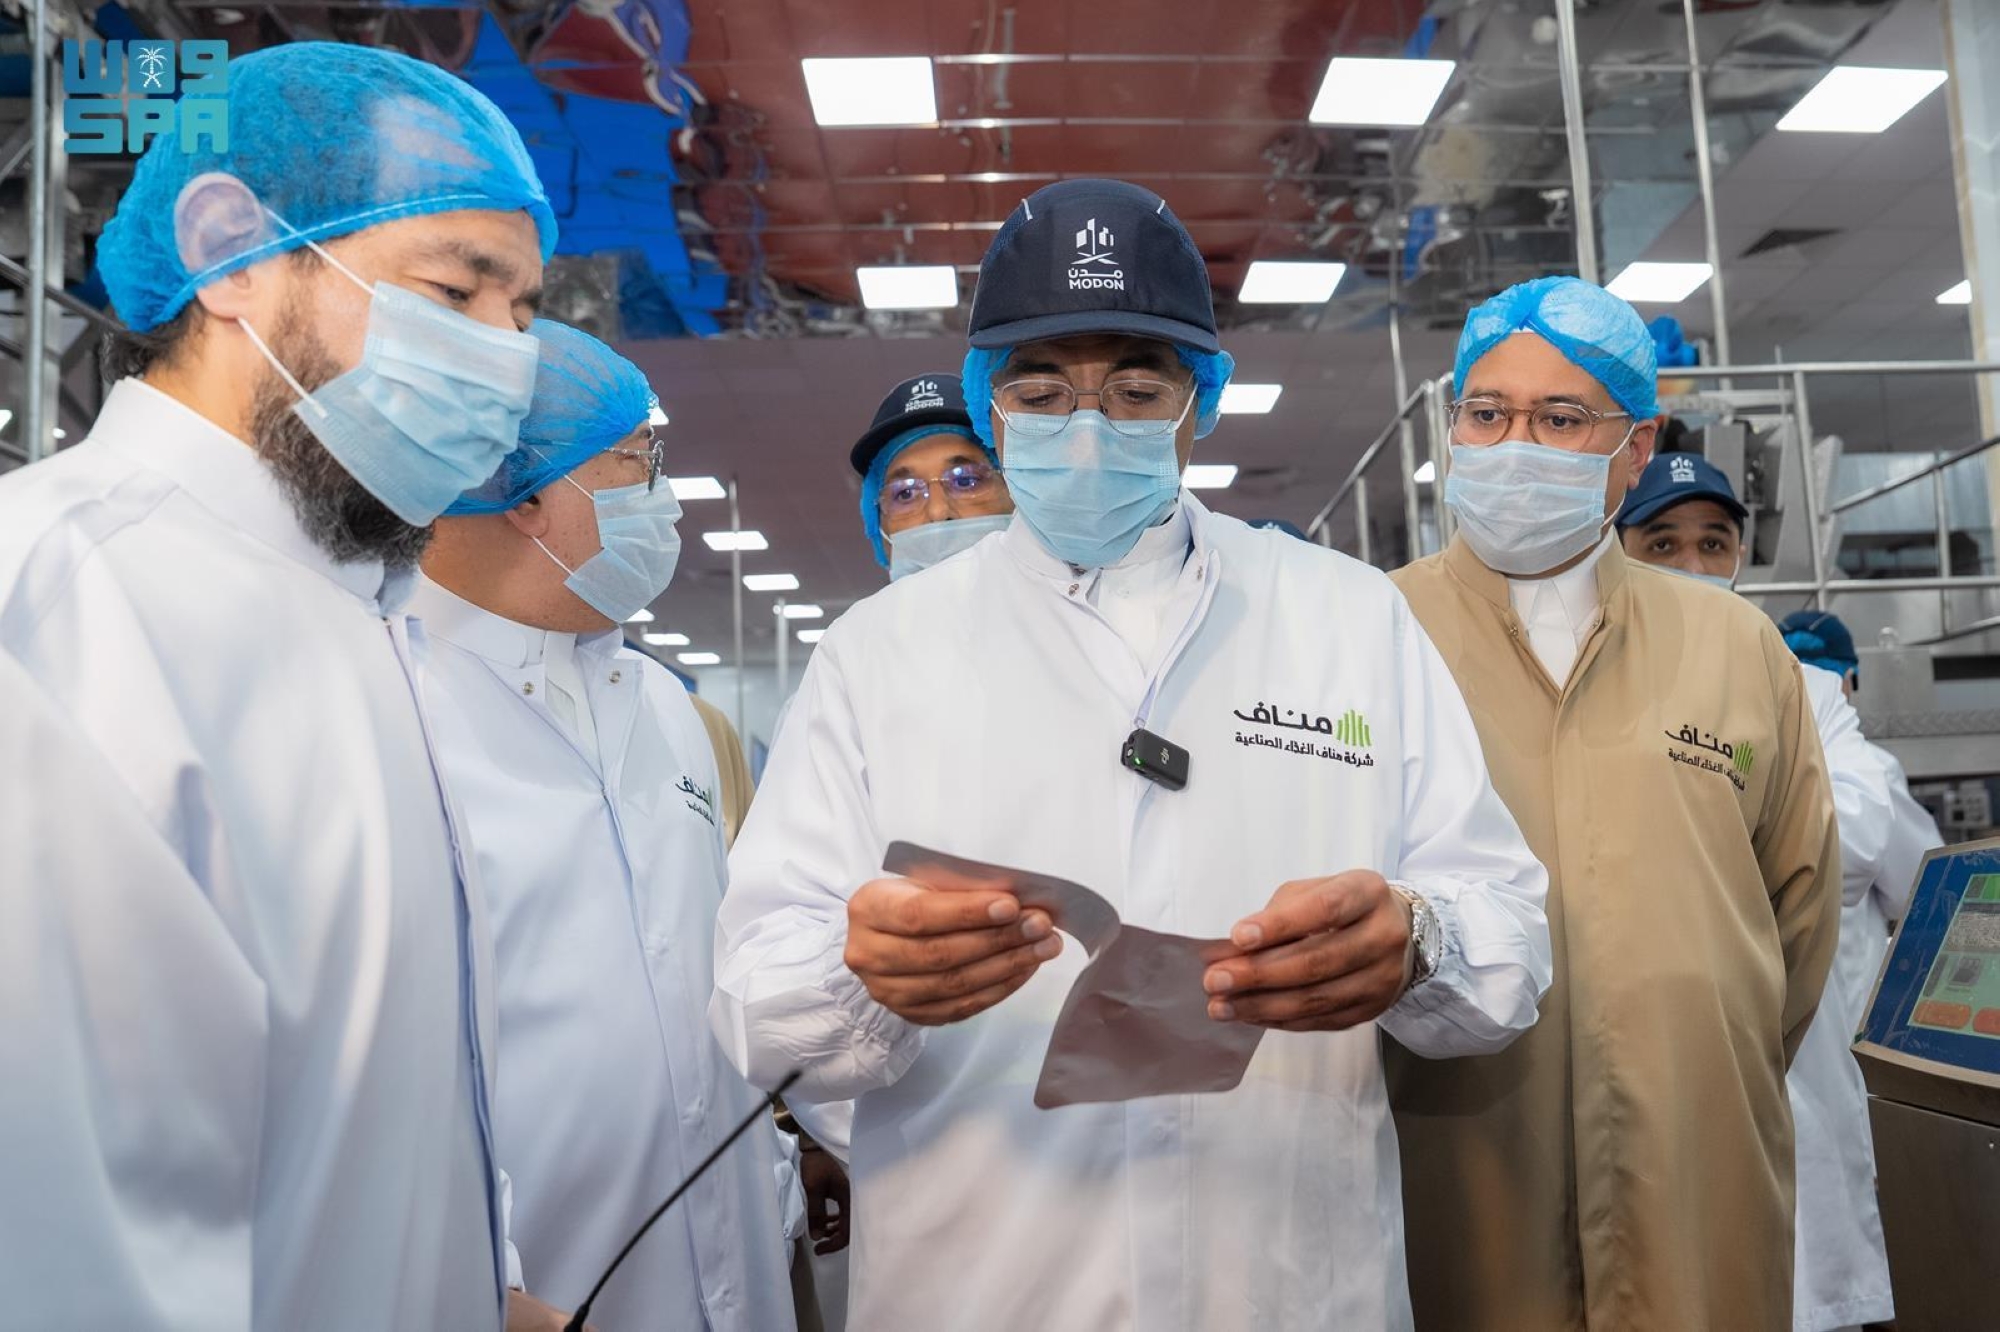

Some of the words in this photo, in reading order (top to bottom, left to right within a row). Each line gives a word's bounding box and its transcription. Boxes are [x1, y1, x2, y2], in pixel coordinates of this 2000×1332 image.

[1068, 268, 1123, 279] مدن
[1069, 279, 1124, 290] MODON
[1233, 701, 1333, 735] مناف
[1235, 731, 1282, 749] الصناعية
[1284, 740, 1315, 755] الغذاء
[1665, 724, 1733, 759] مناف
[1316, 746, 1343, 761] مناف
[1344, 751, 1374, 767] شركة
